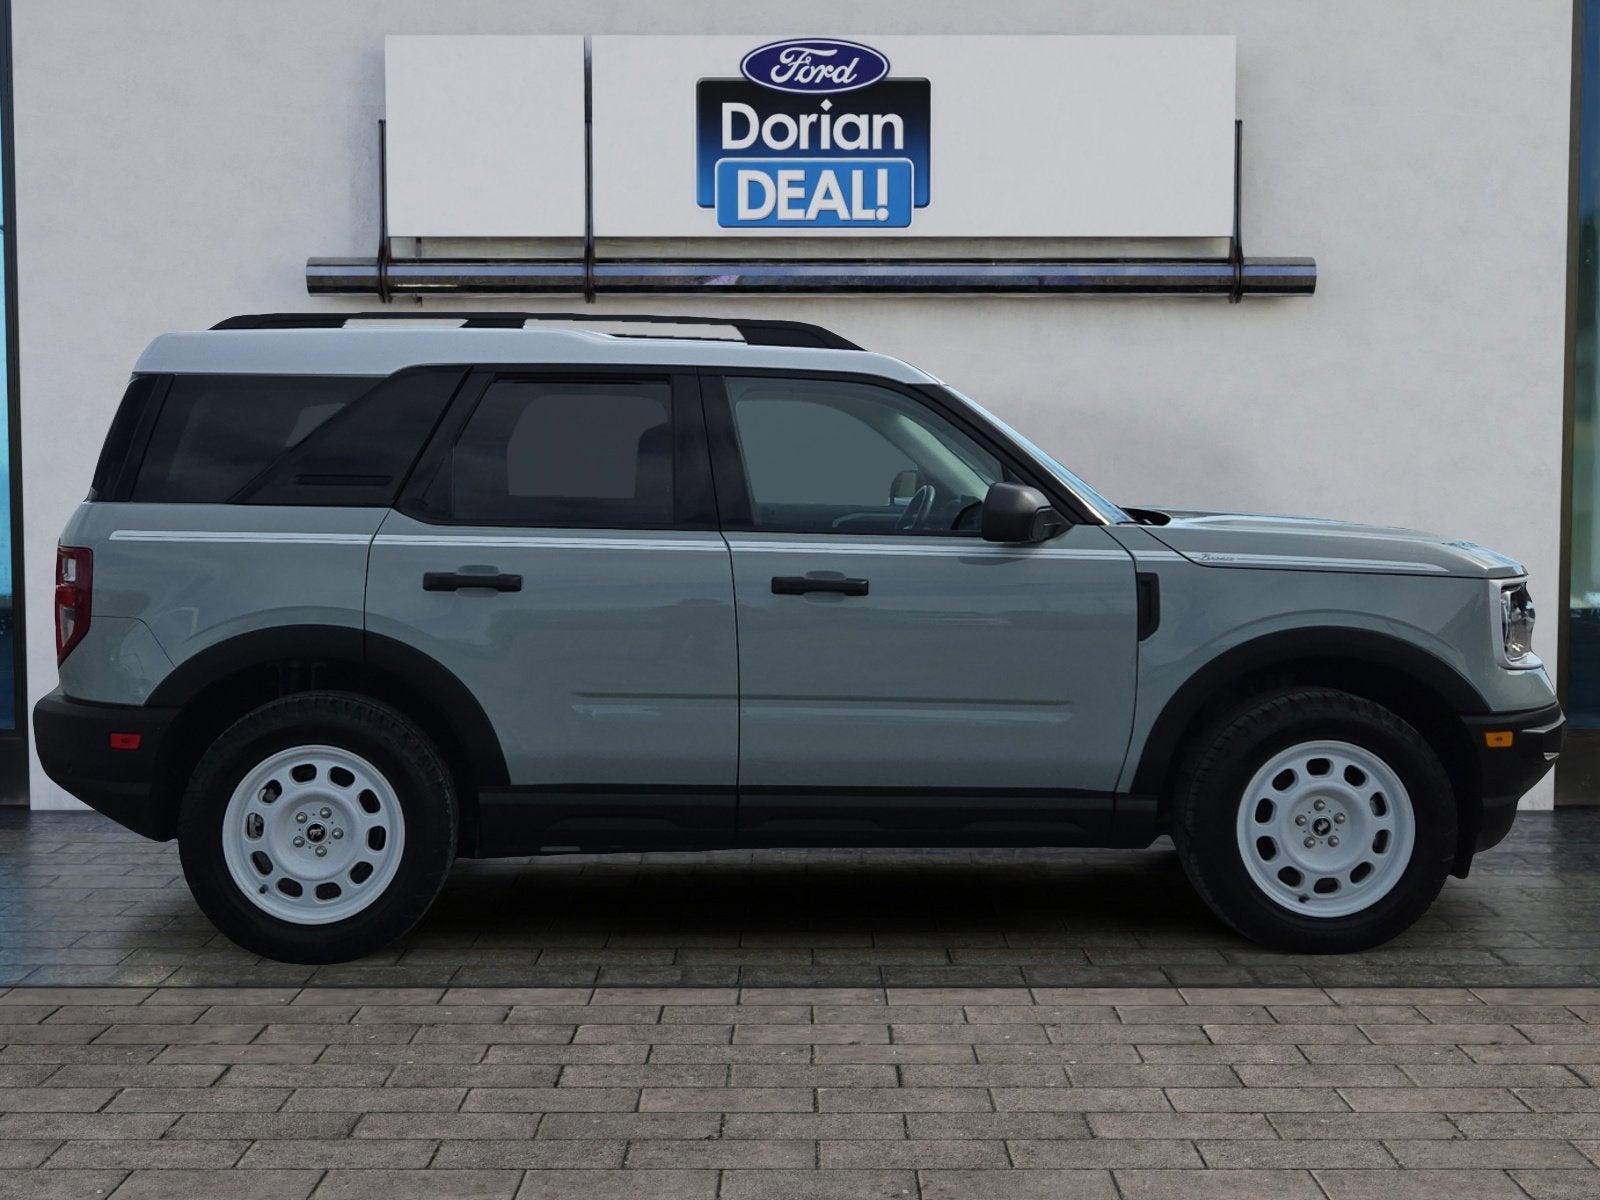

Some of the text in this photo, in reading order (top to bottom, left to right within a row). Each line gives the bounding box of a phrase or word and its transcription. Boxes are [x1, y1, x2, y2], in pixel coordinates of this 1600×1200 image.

[770, 47, 860, 84] Ford
[721, 98, 904, 151] Dorian
[737, 168, 890, 222] DEAL!
